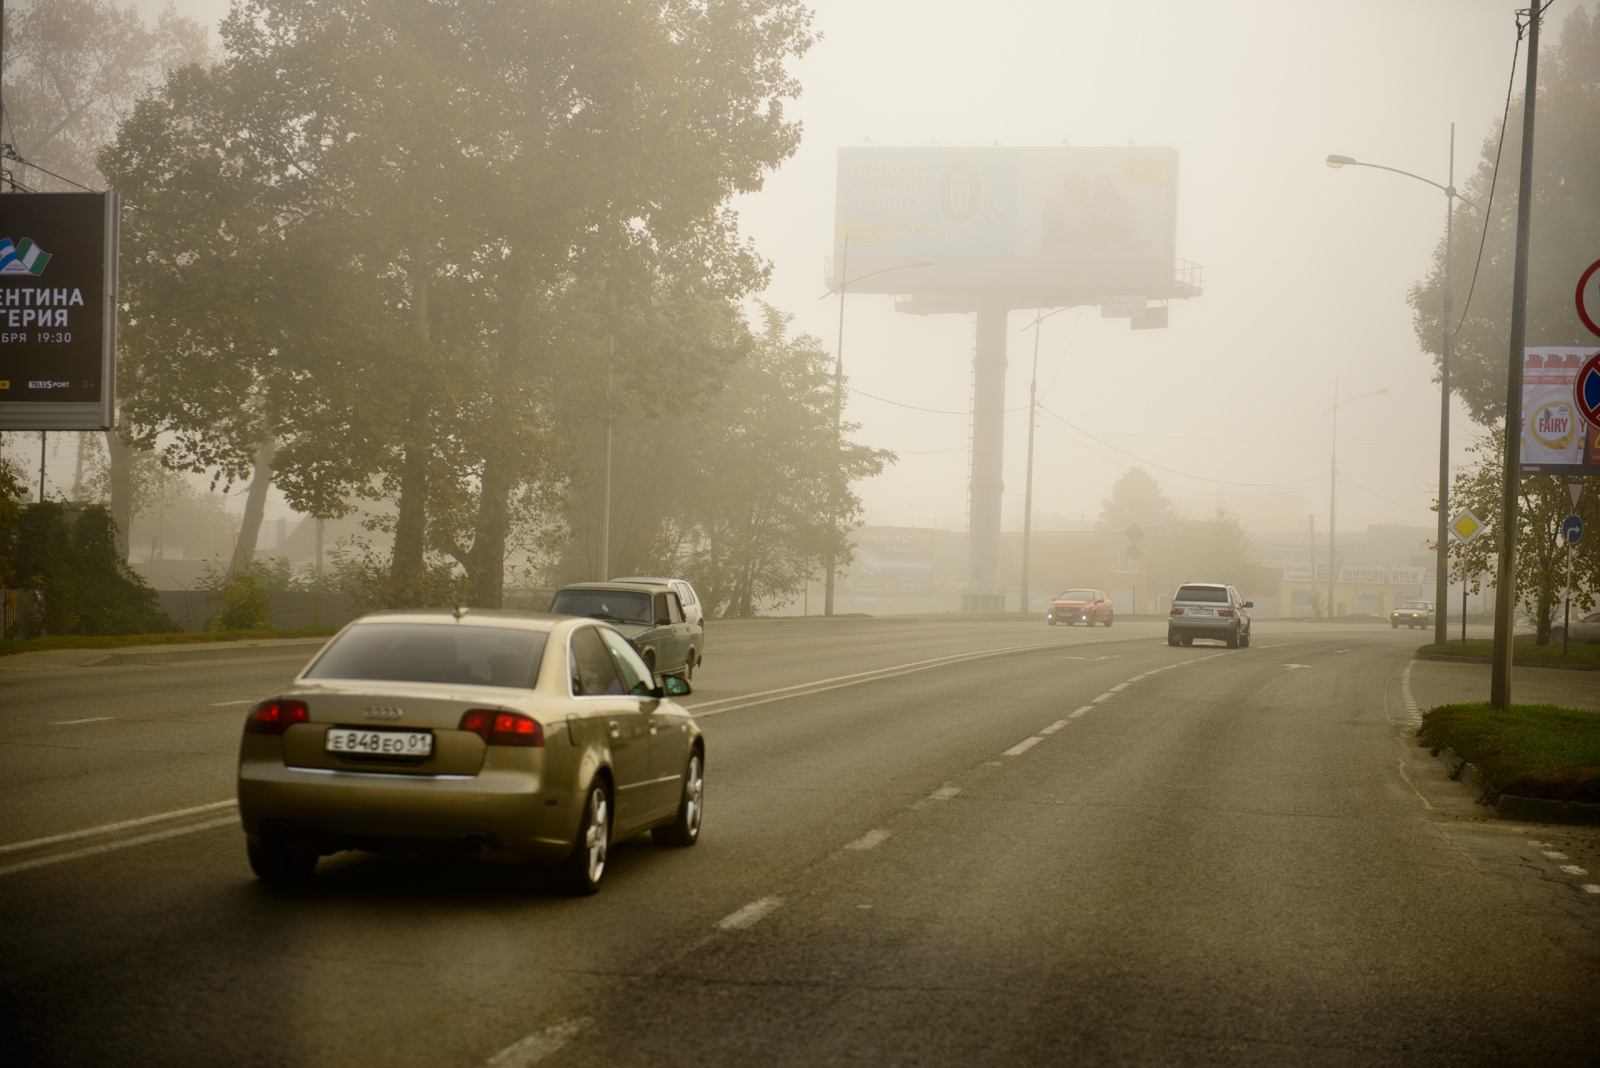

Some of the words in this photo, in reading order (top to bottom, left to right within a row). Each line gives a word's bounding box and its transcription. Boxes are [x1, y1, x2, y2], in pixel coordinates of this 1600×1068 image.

[851, 163, 928, 175] КВАРТИРА
[863, 180, 925, 191] РЕМОНТ
[863, 197, 927, 208] ИПОТЕКУ
[37, 332, 72, 343] 19:30
[1539, 418, 1569, 432] FAIRY
[1343, 570, 1420, 584] ШИНОМНТАЖ
